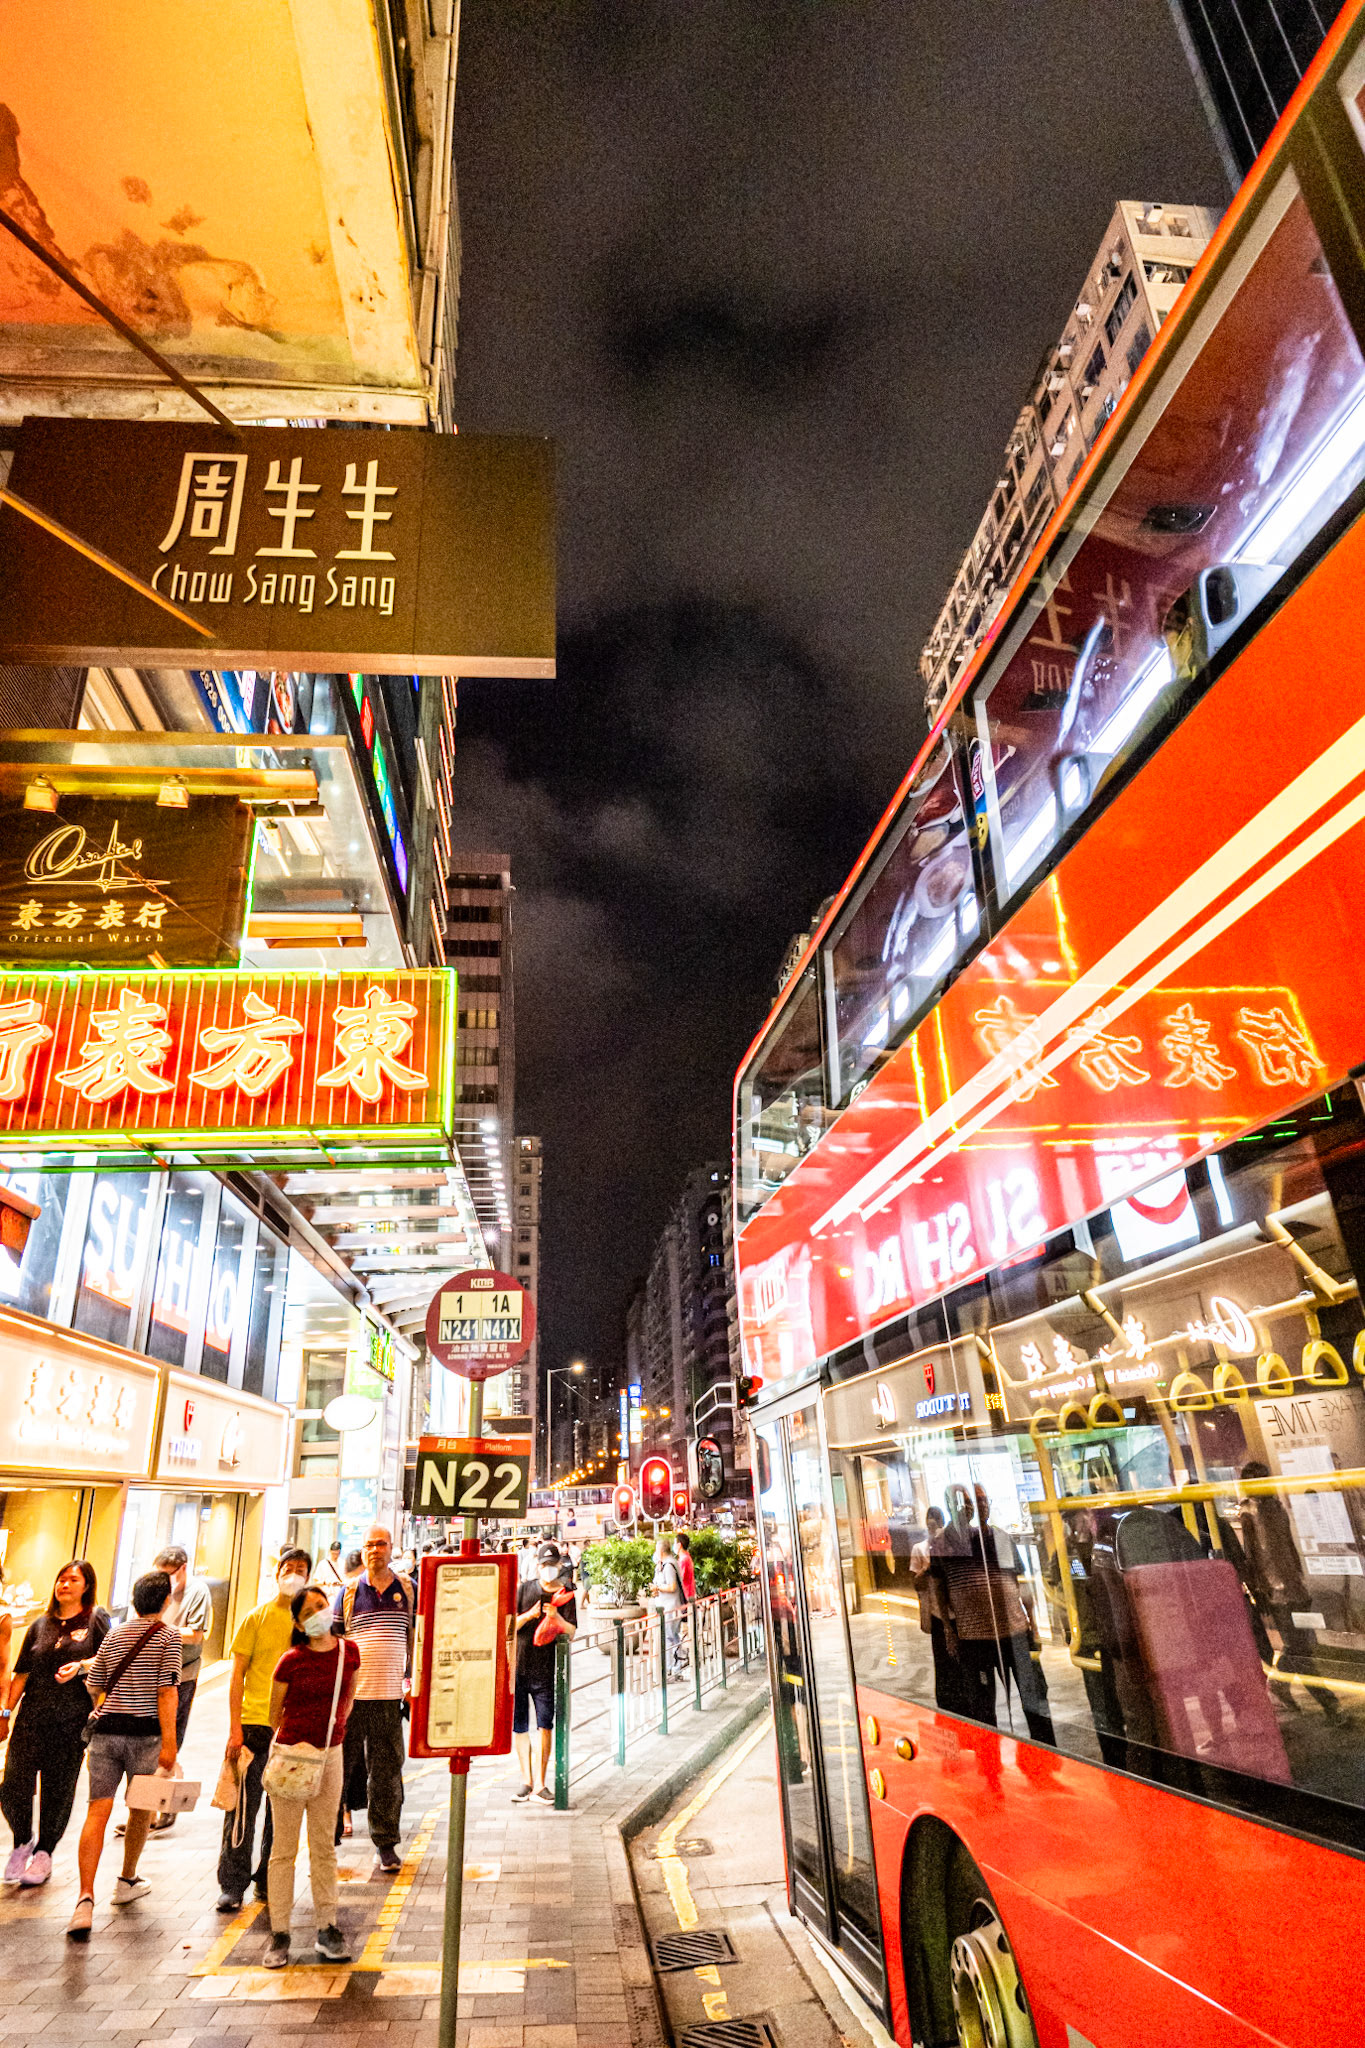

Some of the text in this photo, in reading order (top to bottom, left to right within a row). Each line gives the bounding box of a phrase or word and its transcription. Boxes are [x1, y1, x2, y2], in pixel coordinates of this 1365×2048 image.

[157, 452, 399, 561] 周生生
[152, 563, 397, 615] Chow Sang Sang
[11, 899, 168, 930] 東方表行
[8, 933, 164, 943] Oriental Watch
[456, 1294, 511, 1313] 1 1A
[442, 1320, 519, 1340] N241 N41X
[437, 1440, 457, 1450] 月台
[484, 1443, 513, 1452] Platform
[420, 1460, 522, 1509] N22
